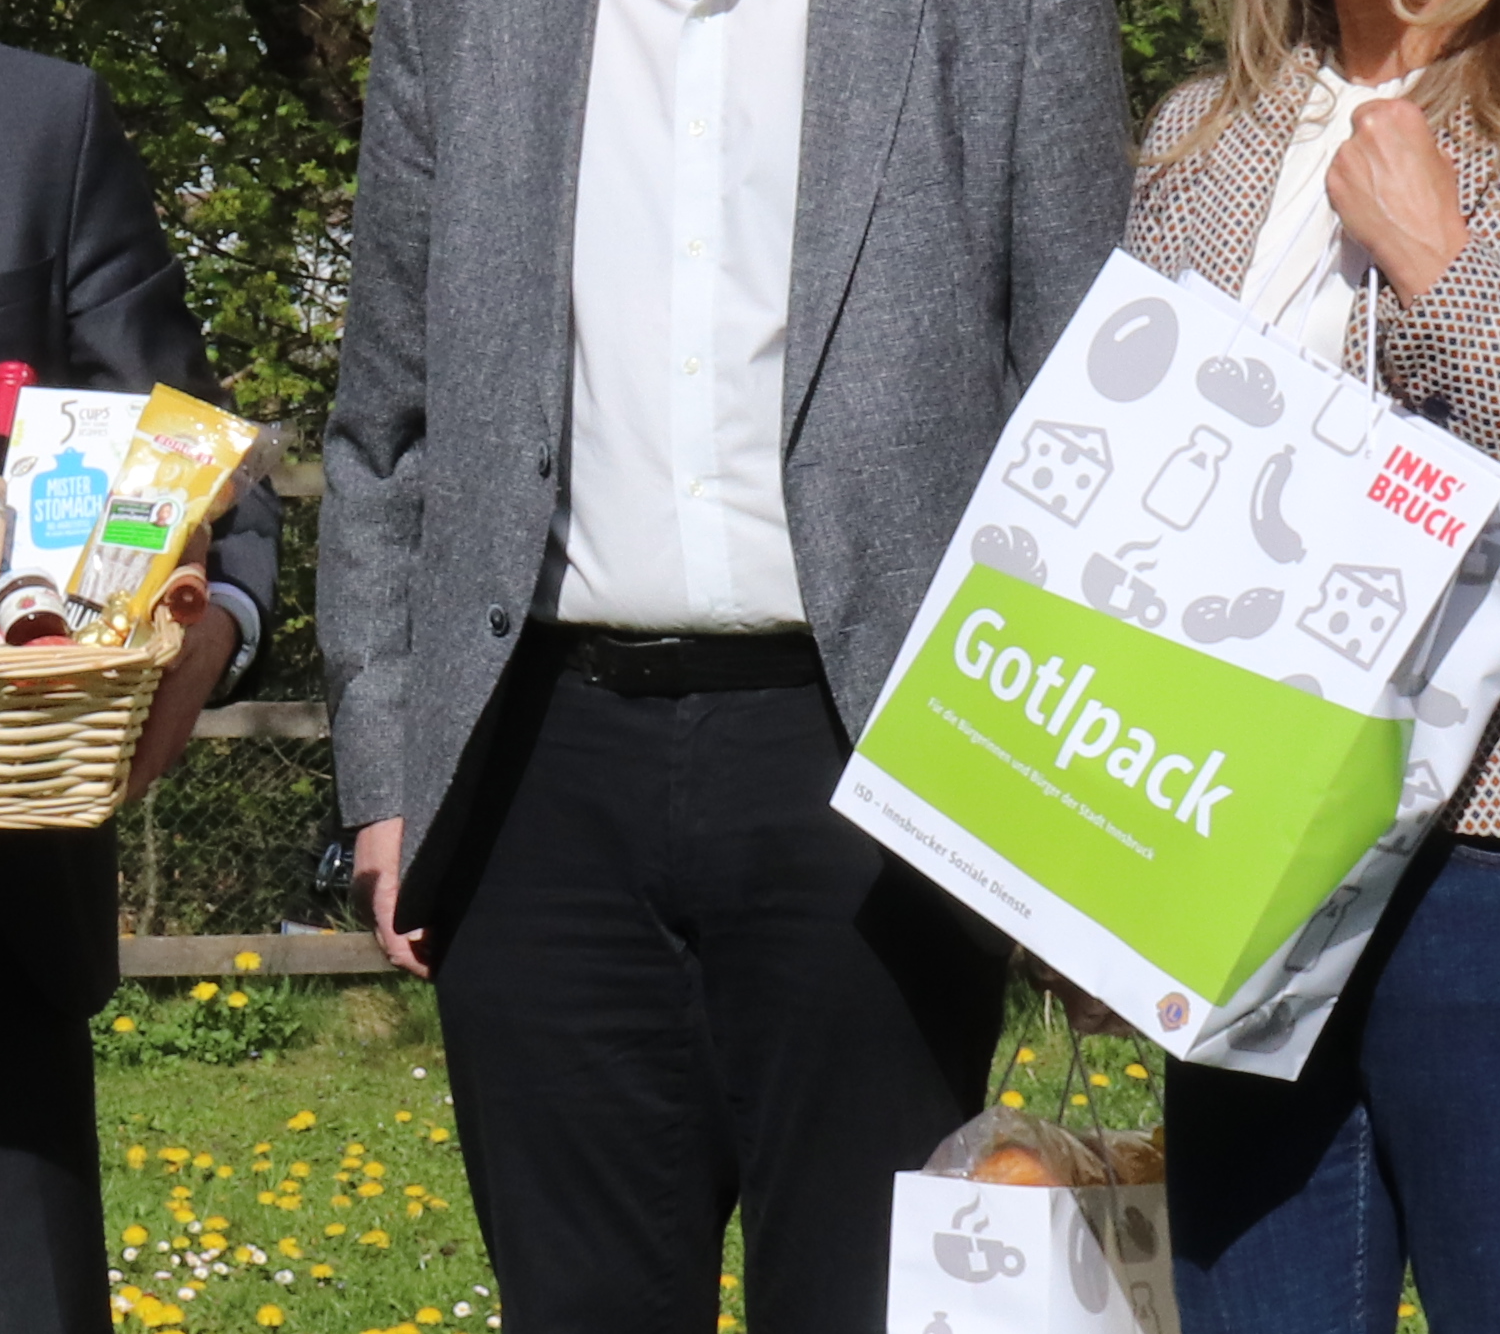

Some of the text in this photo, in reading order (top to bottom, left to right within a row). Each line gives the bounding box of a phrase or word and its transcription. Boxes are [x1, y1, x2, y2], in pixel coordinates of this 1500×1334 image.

[60, 400, 78, 445] 5
[79, 407, 110, 422] CUPS
[34, 494, 103, 522] STOMACH
[46, 475, 92, 498] MISTER
[1367, 473, 1467, 548] BRUCK
[954, 607, 1234, 839] Gotlpack
[927, 696, 944, 714] Für
[942, 706, 959, 725] die
[1011, 757, 1031, 778] und
[1030, 770, 1061, 799] Bürger
[1060, 788, 1079, 809] der
[1078, 803, 1105, 829] Stadt
[1105, 820, 1157, 861] Innsbruck
[853, 782, 873, 803] ISD
[881, 803, 948, 858] Innsbrucker
[949, 851, 989, 888] Soziale
[989, 880, 1032, 920] Dienste
